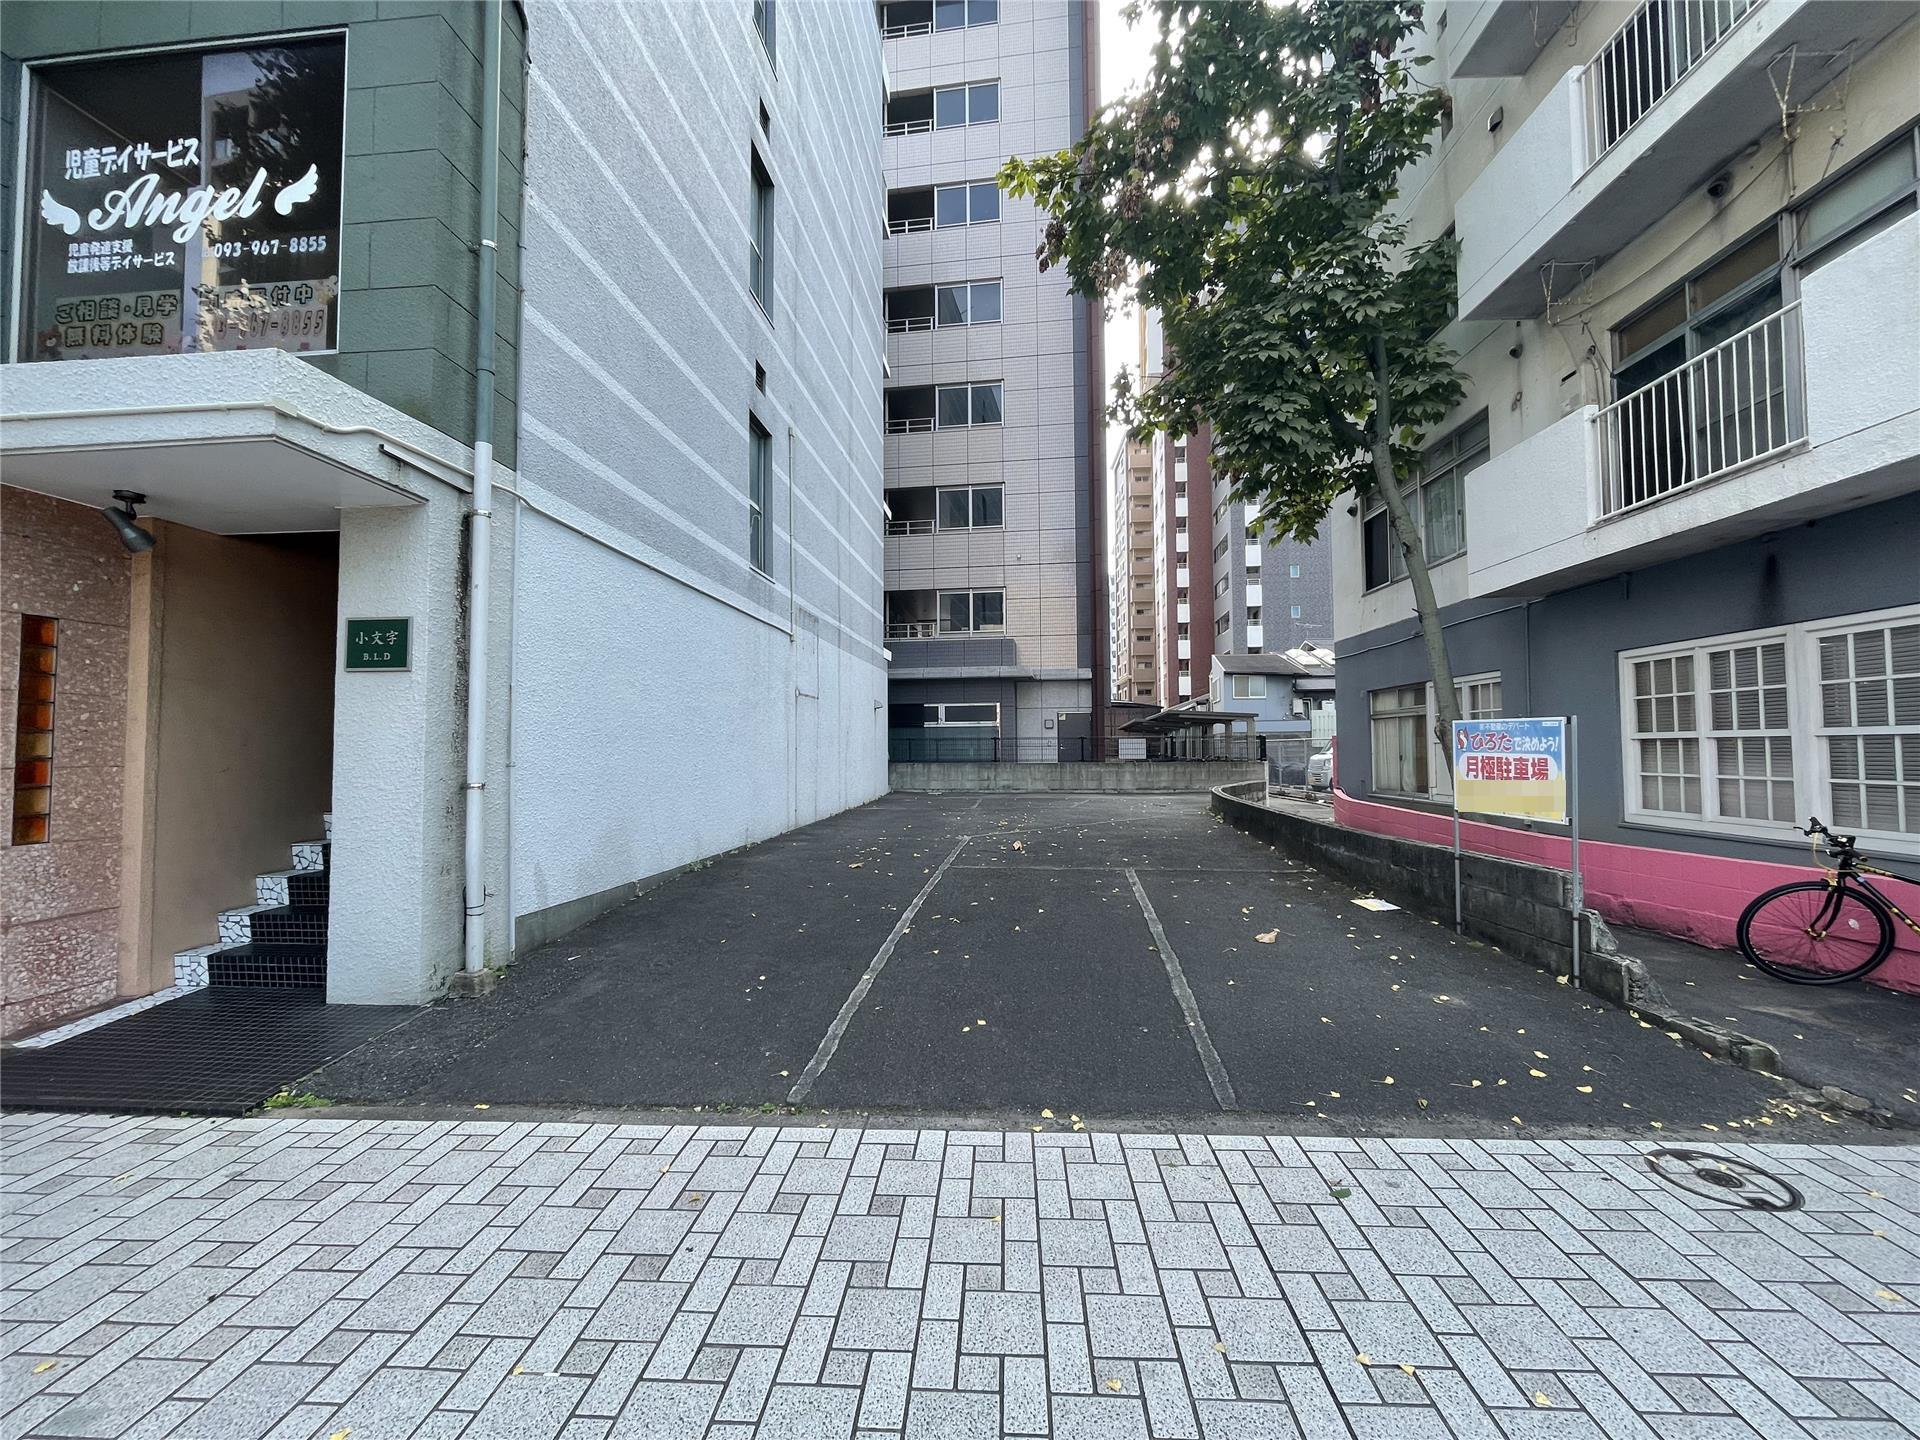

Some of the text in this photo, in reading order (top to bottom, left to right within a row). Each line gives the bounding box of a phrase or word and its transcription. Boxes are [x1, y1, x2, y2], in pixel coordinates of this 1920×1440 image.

[64, 138, 200, 181] 児童デイサービス
[87, 166, 268, 244] Angel
[68, 239, 134, 257] 児童発達支援
[213, 235, 327, 258] 093-967-8855
[67, 251, 176, 274] 放課後等デイサービス
[56, 294, 178, 324] ご相談・見学
[65, 323, 163, 347] 無料体験
[355, 630, 399, 645] 小文字
[1466, 756, 1549, 780] 月極駐車場
